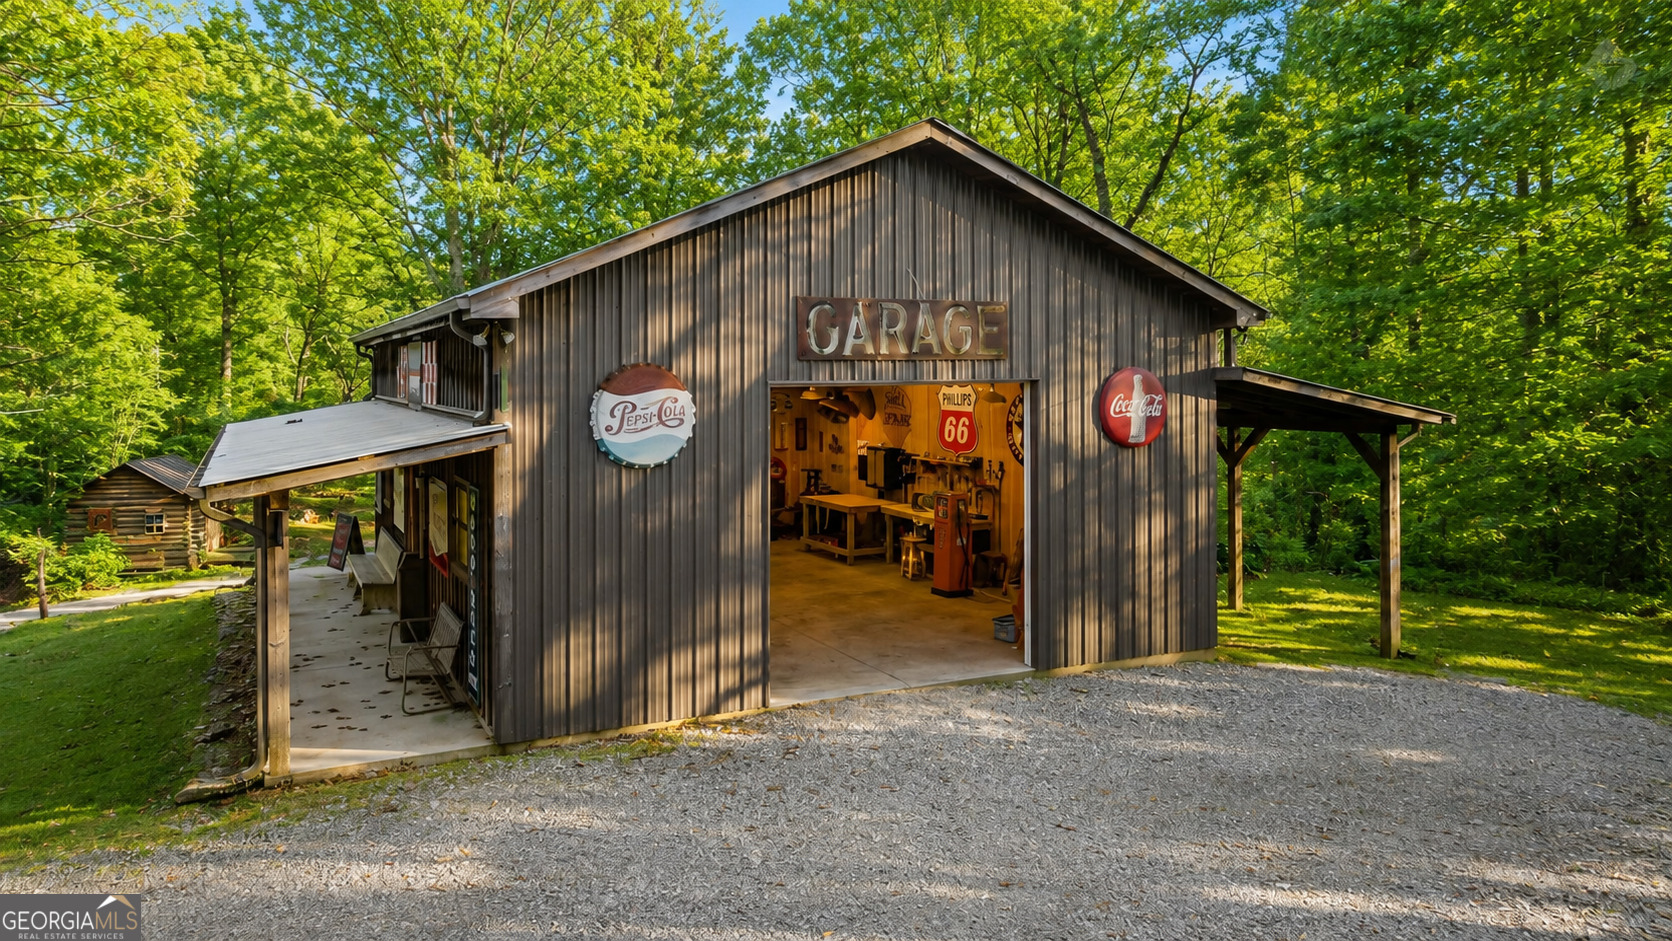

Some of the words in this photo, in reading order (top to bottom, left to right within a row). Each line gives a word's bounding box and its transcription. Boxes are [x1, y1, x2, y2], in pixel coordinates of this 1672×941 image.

[806, 301, 1006, 356] GARAGE
[942, 392, 972, 407] PHILLIPS
[943, 416, 970, 444] 66
